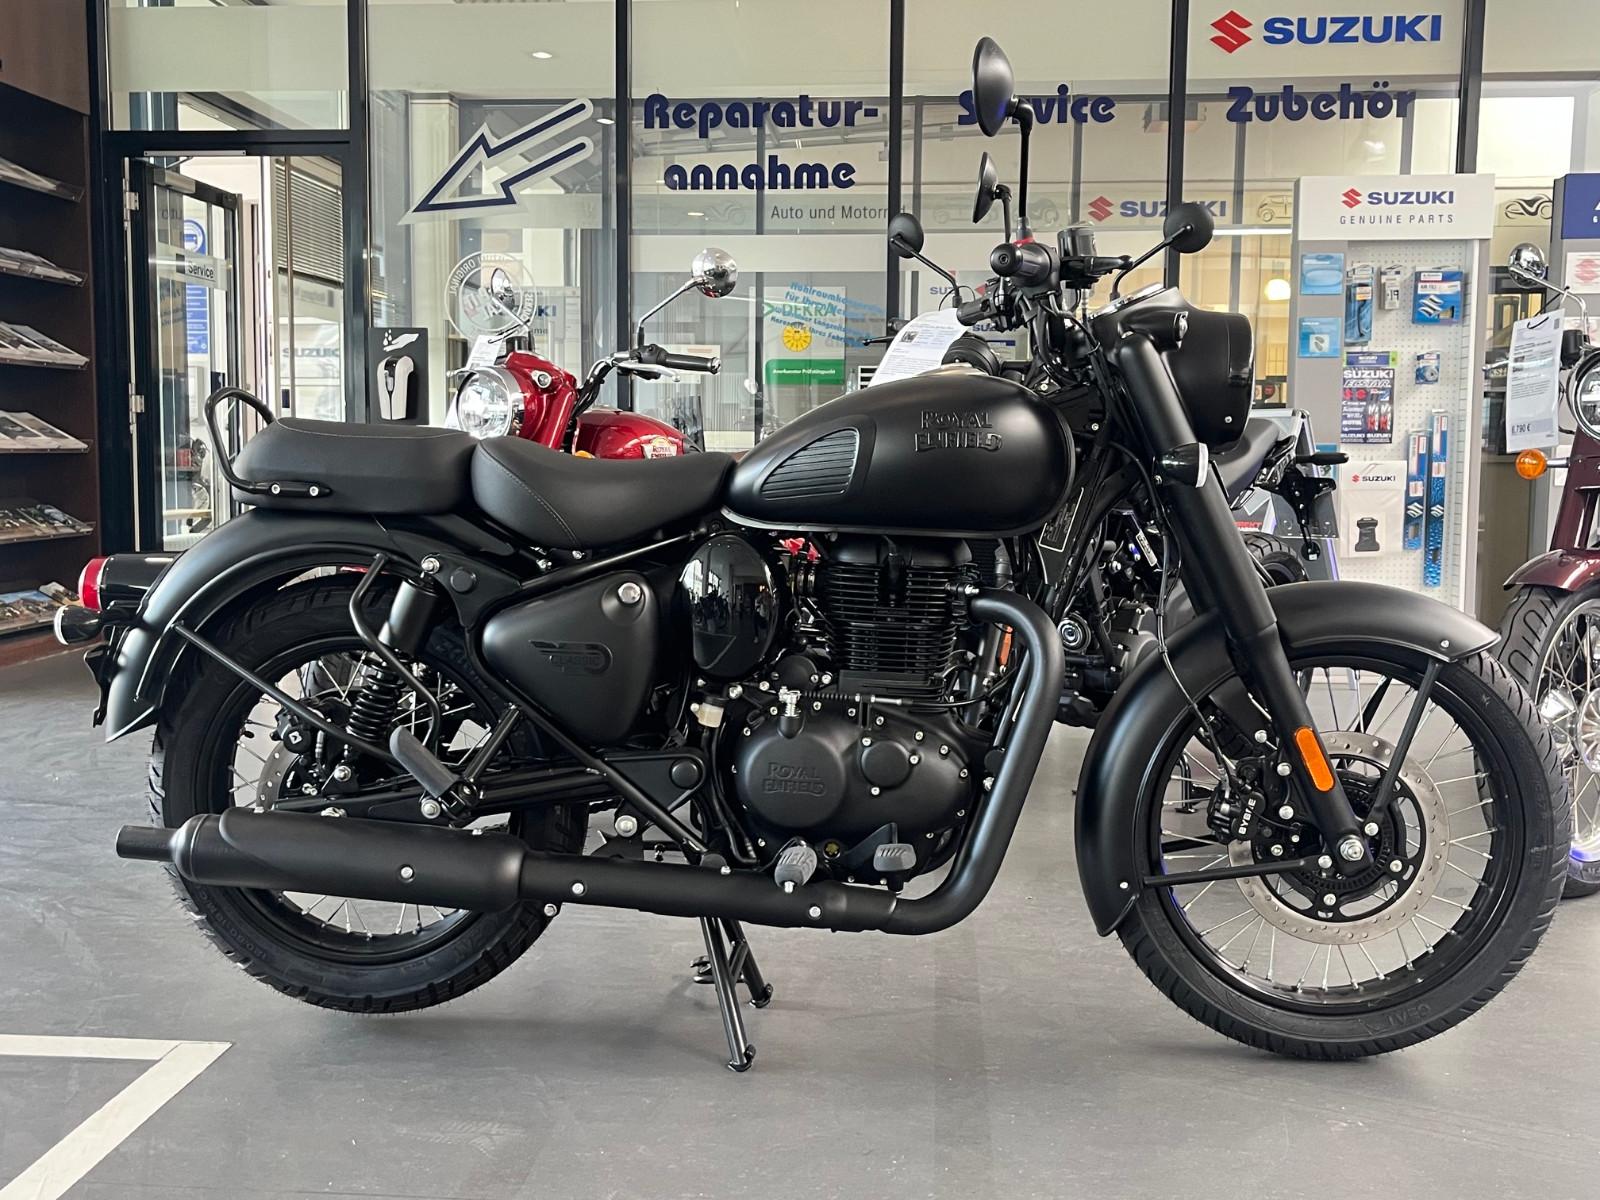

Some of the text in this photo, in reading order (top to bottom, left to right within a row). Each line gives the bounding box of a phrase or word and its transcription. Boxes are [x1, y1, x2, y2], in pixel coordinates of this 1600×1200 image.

[1263, 15, 1442, 45] SUZUKI
[958, 83, 1116, 124] Svice
[1226, 81, 1416, 122] Zubehör
[643, 93, 878, 138] Reparatur-
[664, 155, 856, 190] annahme
[1367, 191, 1454, 205] SUZUKI
[771, 205, 905, 219] Auto und Motorrd
[1340, 214, 1454, 225] GENUINE PARTS
[187, 261, 214, 279] Service
[782, 303, 836, 317] DEKRA
[1343, 370, 1394, 379] SUZUKI
[920, 409, 993, 429] ROYAL
[768, 761, 822, 780] ROYAL
[762, 778, 827, 797] ENFIELD
